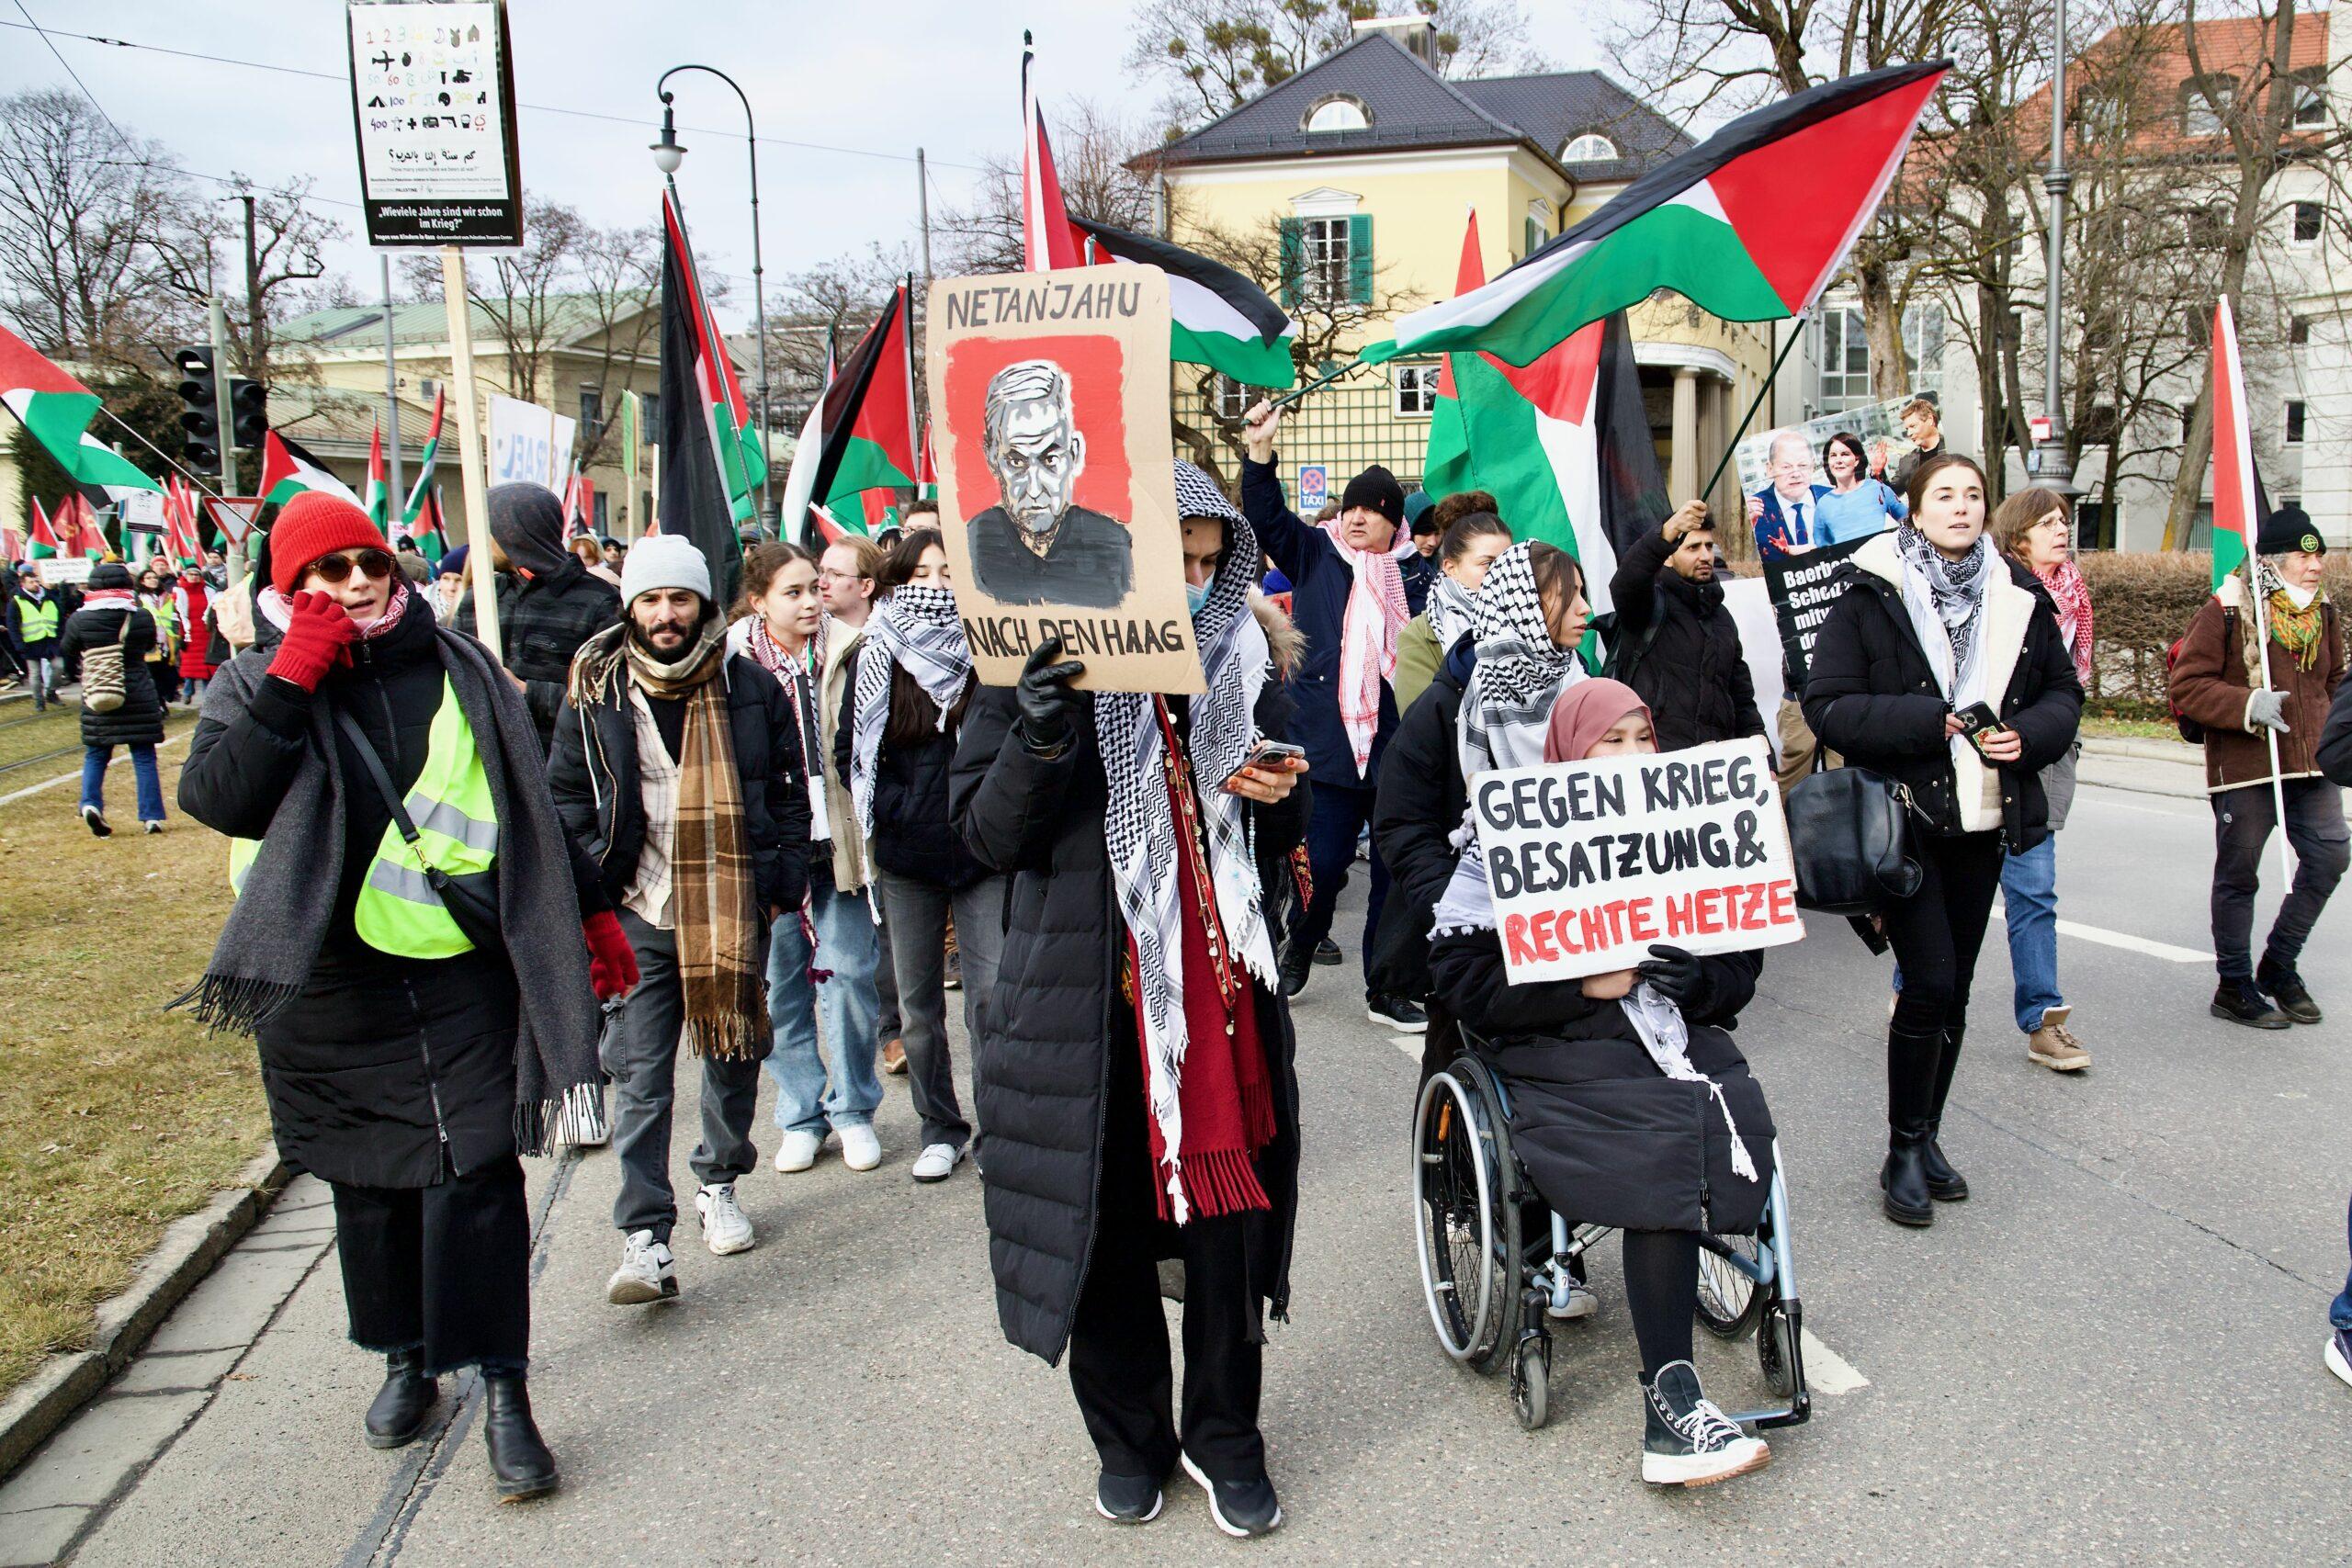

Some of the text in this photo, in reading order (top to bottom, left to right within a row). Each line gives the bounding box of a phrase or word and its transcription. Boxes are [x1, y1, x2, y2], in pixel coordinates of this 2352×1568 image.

[390, 96, 404, 107] 100
[418, 206, 442, 217] Jahre
[442, 206, 461, 217] sind
[461, 206, 477, 217] wir
[477, 206, 503, 217] schon
[418, 219, 431, 229] im
[947, 281, 1141, 330] NETANJAHU
[1302, 495, 1325, 506] TAXI
[1783, 552, 1858, 589] Baerb
[962, 616, 1185, 658] NACH DEN HAAG
[1478, 755, 1770, 831] GEGEN KRIEG,
[1504, 879, 1795, 965] RECHTE HETZE
